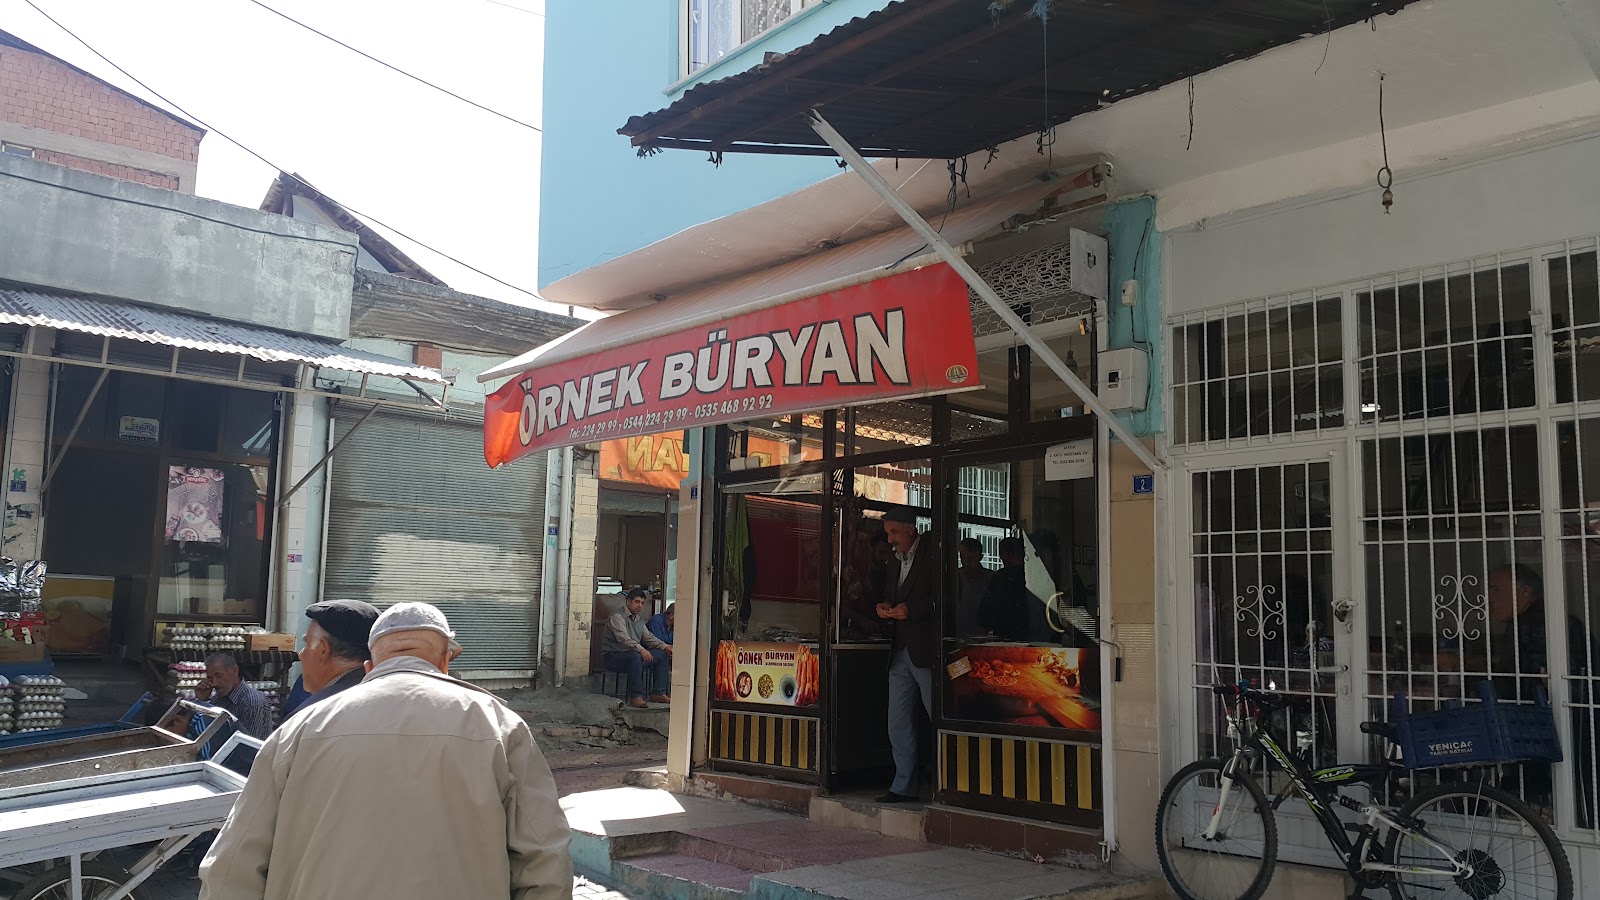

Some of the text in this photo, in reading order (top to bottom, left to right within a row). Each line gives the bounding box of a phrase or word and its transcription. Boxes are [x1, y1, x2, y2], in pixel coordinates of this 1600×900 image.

[518, 306, 911, 447] ÖRNEK BÜRYAN
[581, 423, 595, 437] 224
[596, 420, 606, 434] 29
[607, 418, 617, 432] 99
[623, 414, 643, 431] 0544
[645, 410, 661, 428] 224
[663, 408, 674, 423] 29
[676, 406, 688, 421] 99
[695, 402, 718, 419] 0535
[720, 399, 740, 415] 468
[742, 396, 756, 412] 92
[758, 393, 773, 410] 92
[1140, 479, 1146, 490] 2
[738, 647, 795, 666] ÖRNEK BÜRYAN
[1318, 767, 1355, 780] ALFA
